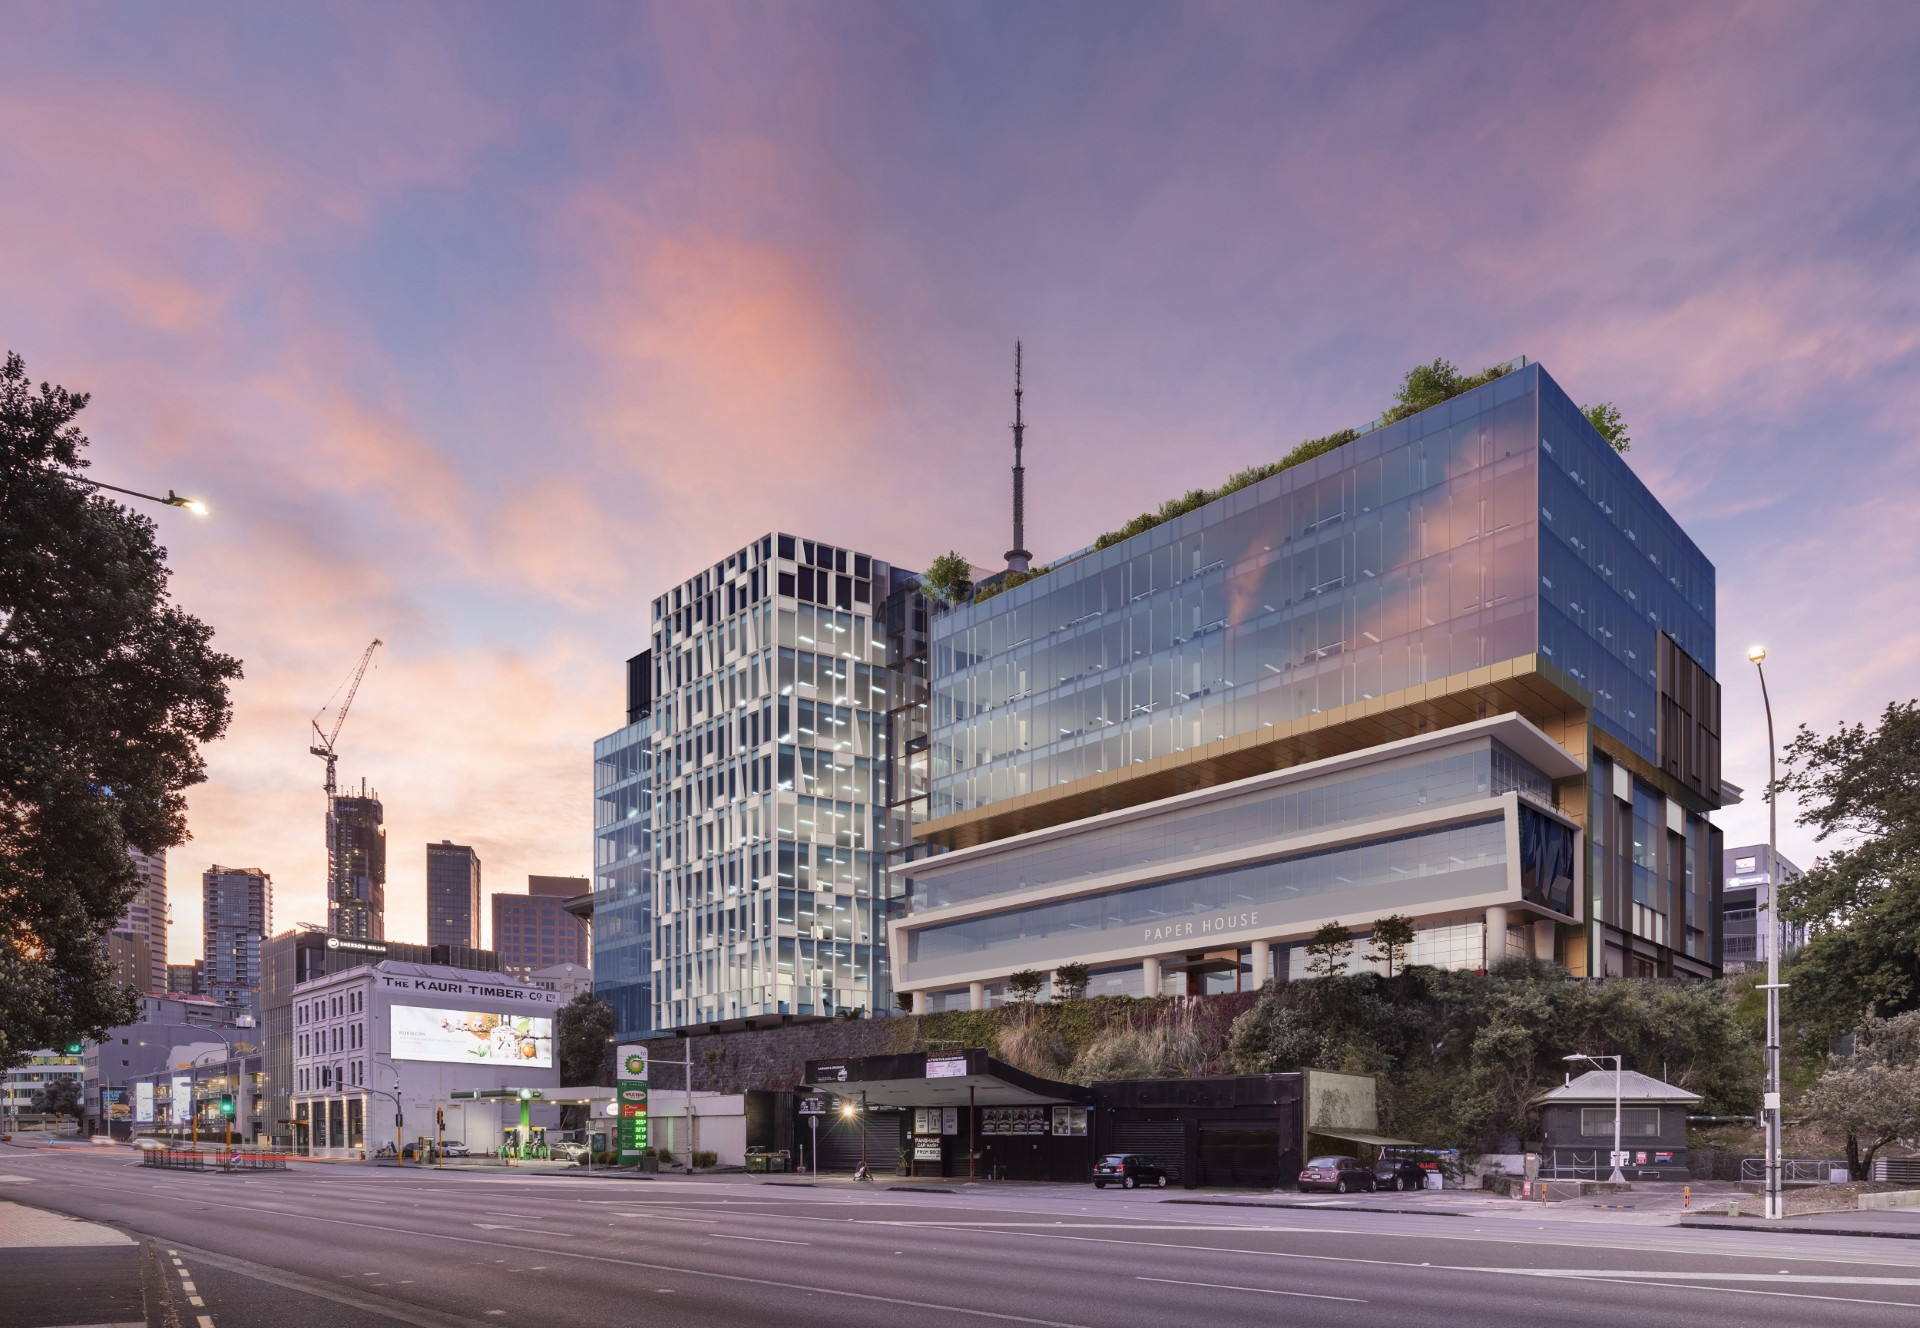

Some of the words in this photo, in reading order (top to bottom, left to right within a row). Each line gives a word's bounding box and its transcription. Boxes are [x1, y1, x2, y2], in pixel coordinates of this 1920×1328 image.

[1145, 923, 1193, 941] PAPER
[1203, 912, 1258, 932] HOUSE
[382, 976, 409, 988] THE
[415, 980, 462, 993] KAURI
[468, 985, 523, 999] TIMBER
